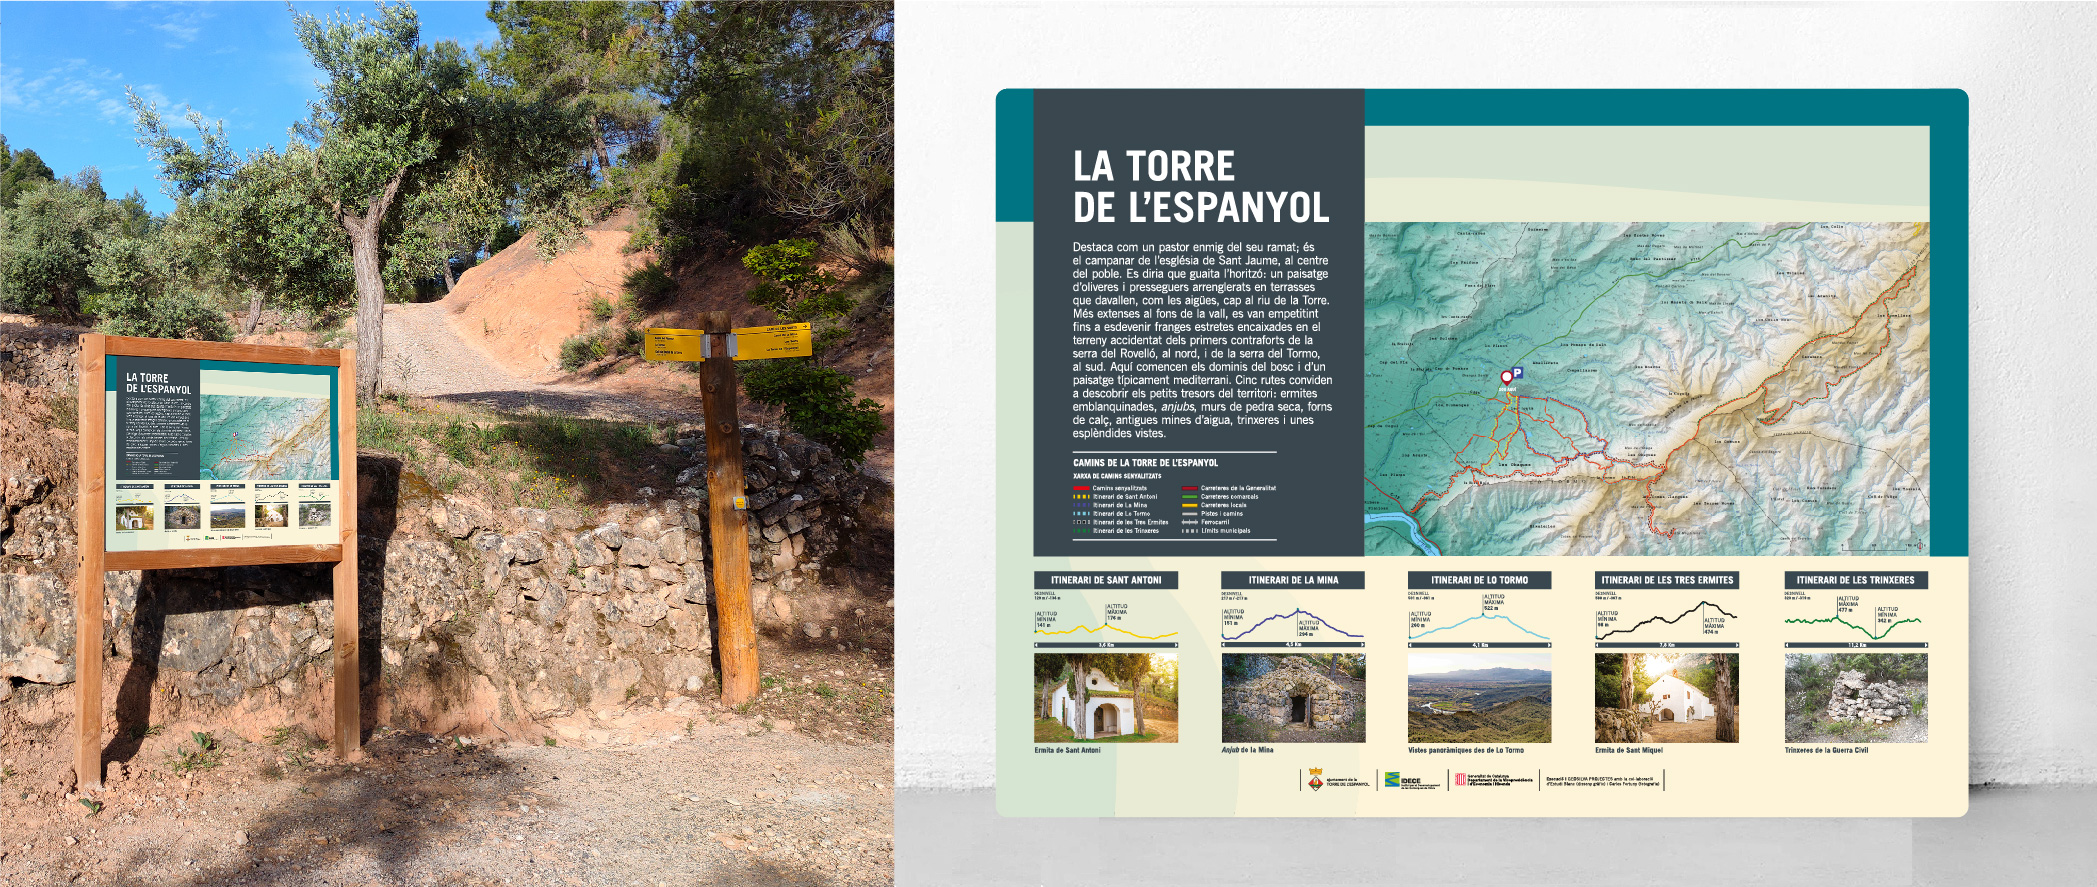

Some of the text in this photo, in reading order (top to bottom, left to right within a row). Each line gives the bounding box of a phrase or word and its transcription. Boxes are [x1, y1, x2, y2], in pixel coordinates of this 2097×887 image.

[1075, 150, 1235, 182] LA TORRE
[1073, 242, 1113, 252] Destaca
[1159, 242, 1190, 254] pastor
[1193, 242, 1224, 254] enmig
[1227, 242, 1242, 252] del
[1267, 242, 1299, 254] ramat;
[1303, 242, 1315, 252] és
[1072, 255, 1081, 265] el
[1085, 257, 1135, 267] campanar
[1138, 255, 1150, 265] de
[1202, 255, 1215, 265] de
[1218, 255, 1242, 265] Sant
[1245, 255, 1280, 266] Jaume,
[1284, 255, 1293, 265] al
[1297, 256, 1328, 265] centre
[1072, 268, 1088, 278] del
[1092, 268, 1122, 280] poble.
[1126, 268, 1139, 278] Es
[1142, 268, 1164, 278] diria
[1168, 270, 1186, 280] que
[1189, 268, 1220, 280] guaita
[1270, 270, 1283, 278] un
[1287, 268, 1328, 280] paisatge
[1130, 284, 1189, 294] presseguers
[1192, 282, 1251, 294] arrenglerats
[1270, 282, 1316, 292] terrasses
[1073, 334, 1313, 347] terreny accidentat dels primers contraforts de la
[126, 372, 169, 384] LA TORRE
[1073, 374, 1332, 387] paisatge típicament mediterrani. Cinc rutes conviden
[1072, 401, 1332, 413] emblanquinades, anjubs, murs de pedra seca, forns
[1073, 458, 1105, 467] CAMINS
[1108, 458, 1118, 467] DE
[1120, 458, 1130, 467] LA
[1132, 458, 1157, 467] TORRE
[1160, 458, 1170, 467] DE
[1051, 576, 1162, 584] ITINERARI DE SANT ANTONI
[1249, 576, 1339, 584] ITINERARI DE LA MINA
[1432, 576, 1528, 584] ITINERARI DE LO TORMO
[1602, 576, 1734, 584] ITINERARI DE LES TRES ERMITES
[1797, 576, 1915, 584] ITINERARI DE LES TRINXERES
[1221, 746, 1240, 754] Anjub
[1429, 746, 1472, 754] panoràmiques
